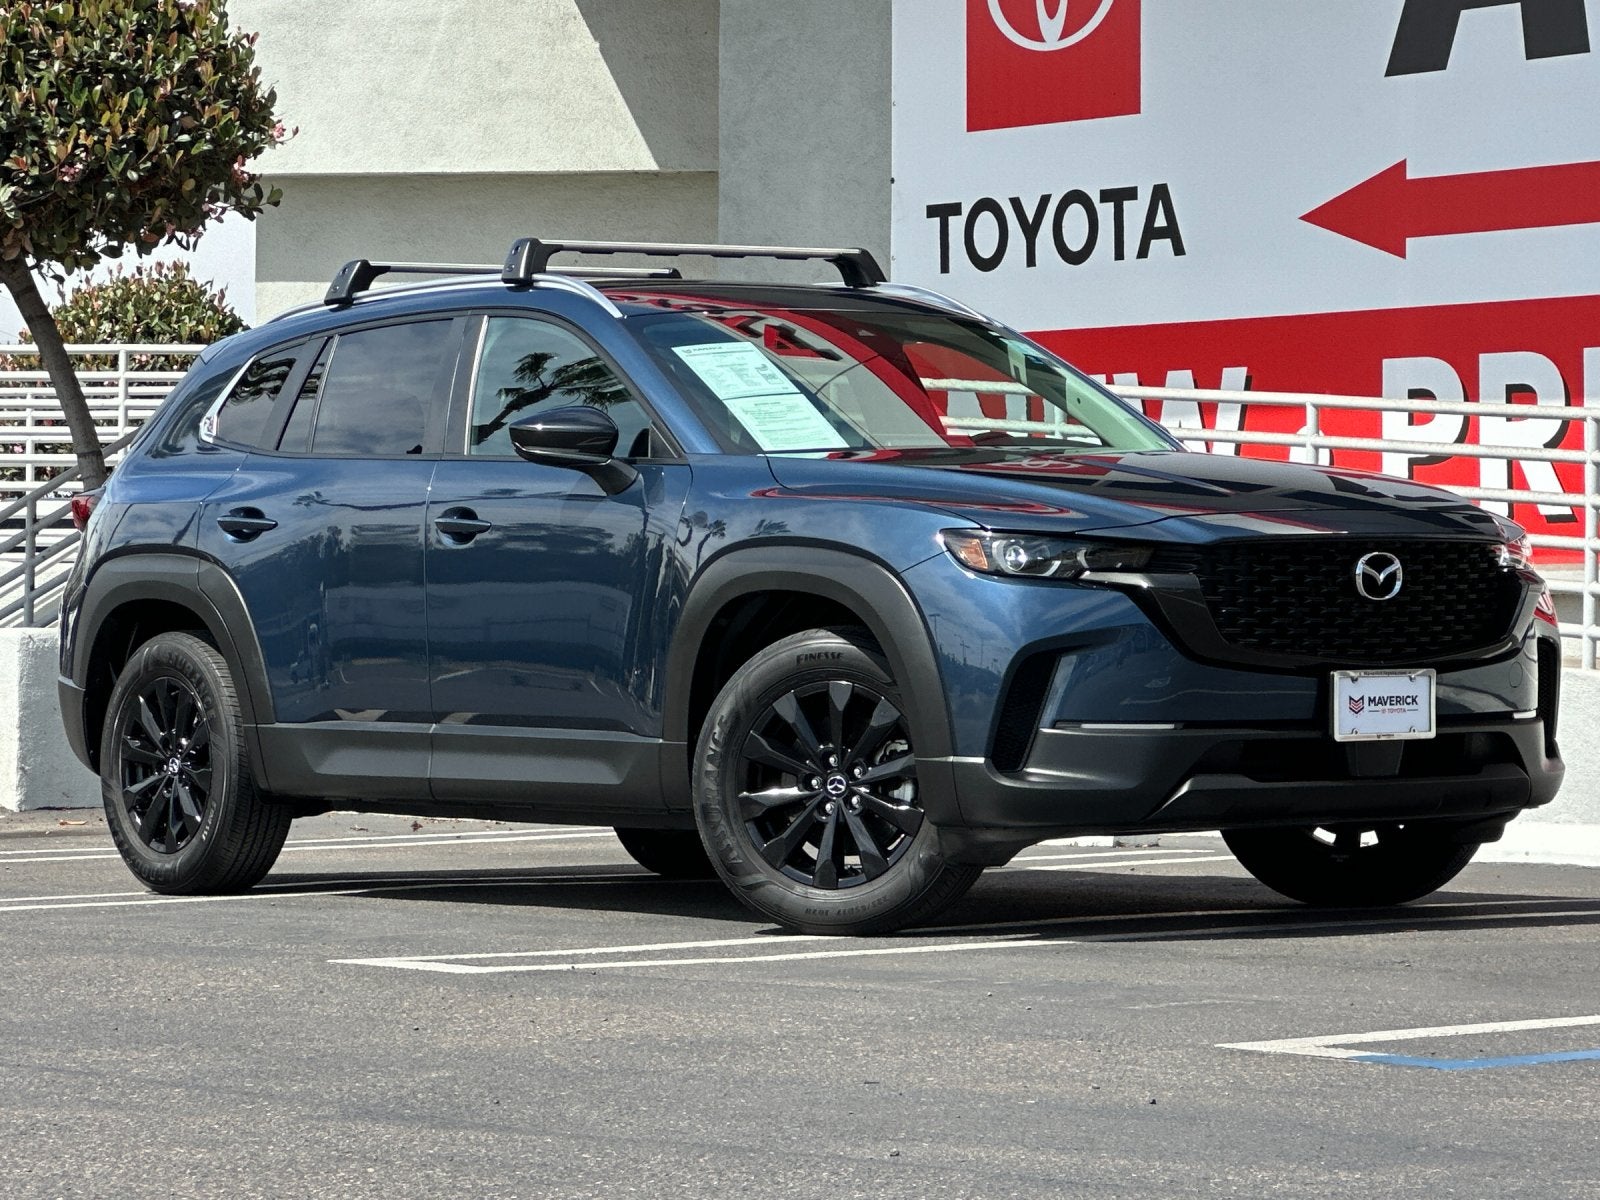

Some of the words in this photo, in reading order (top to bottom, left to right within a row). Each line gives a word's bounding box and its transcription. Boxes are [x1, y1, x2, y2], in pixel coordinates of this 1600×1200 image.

[926, 183, 1186, 274] TOYOTA
[1382, 347, 1600, 523] PR
[1368, 695, 1418, 706] MAVERICK
